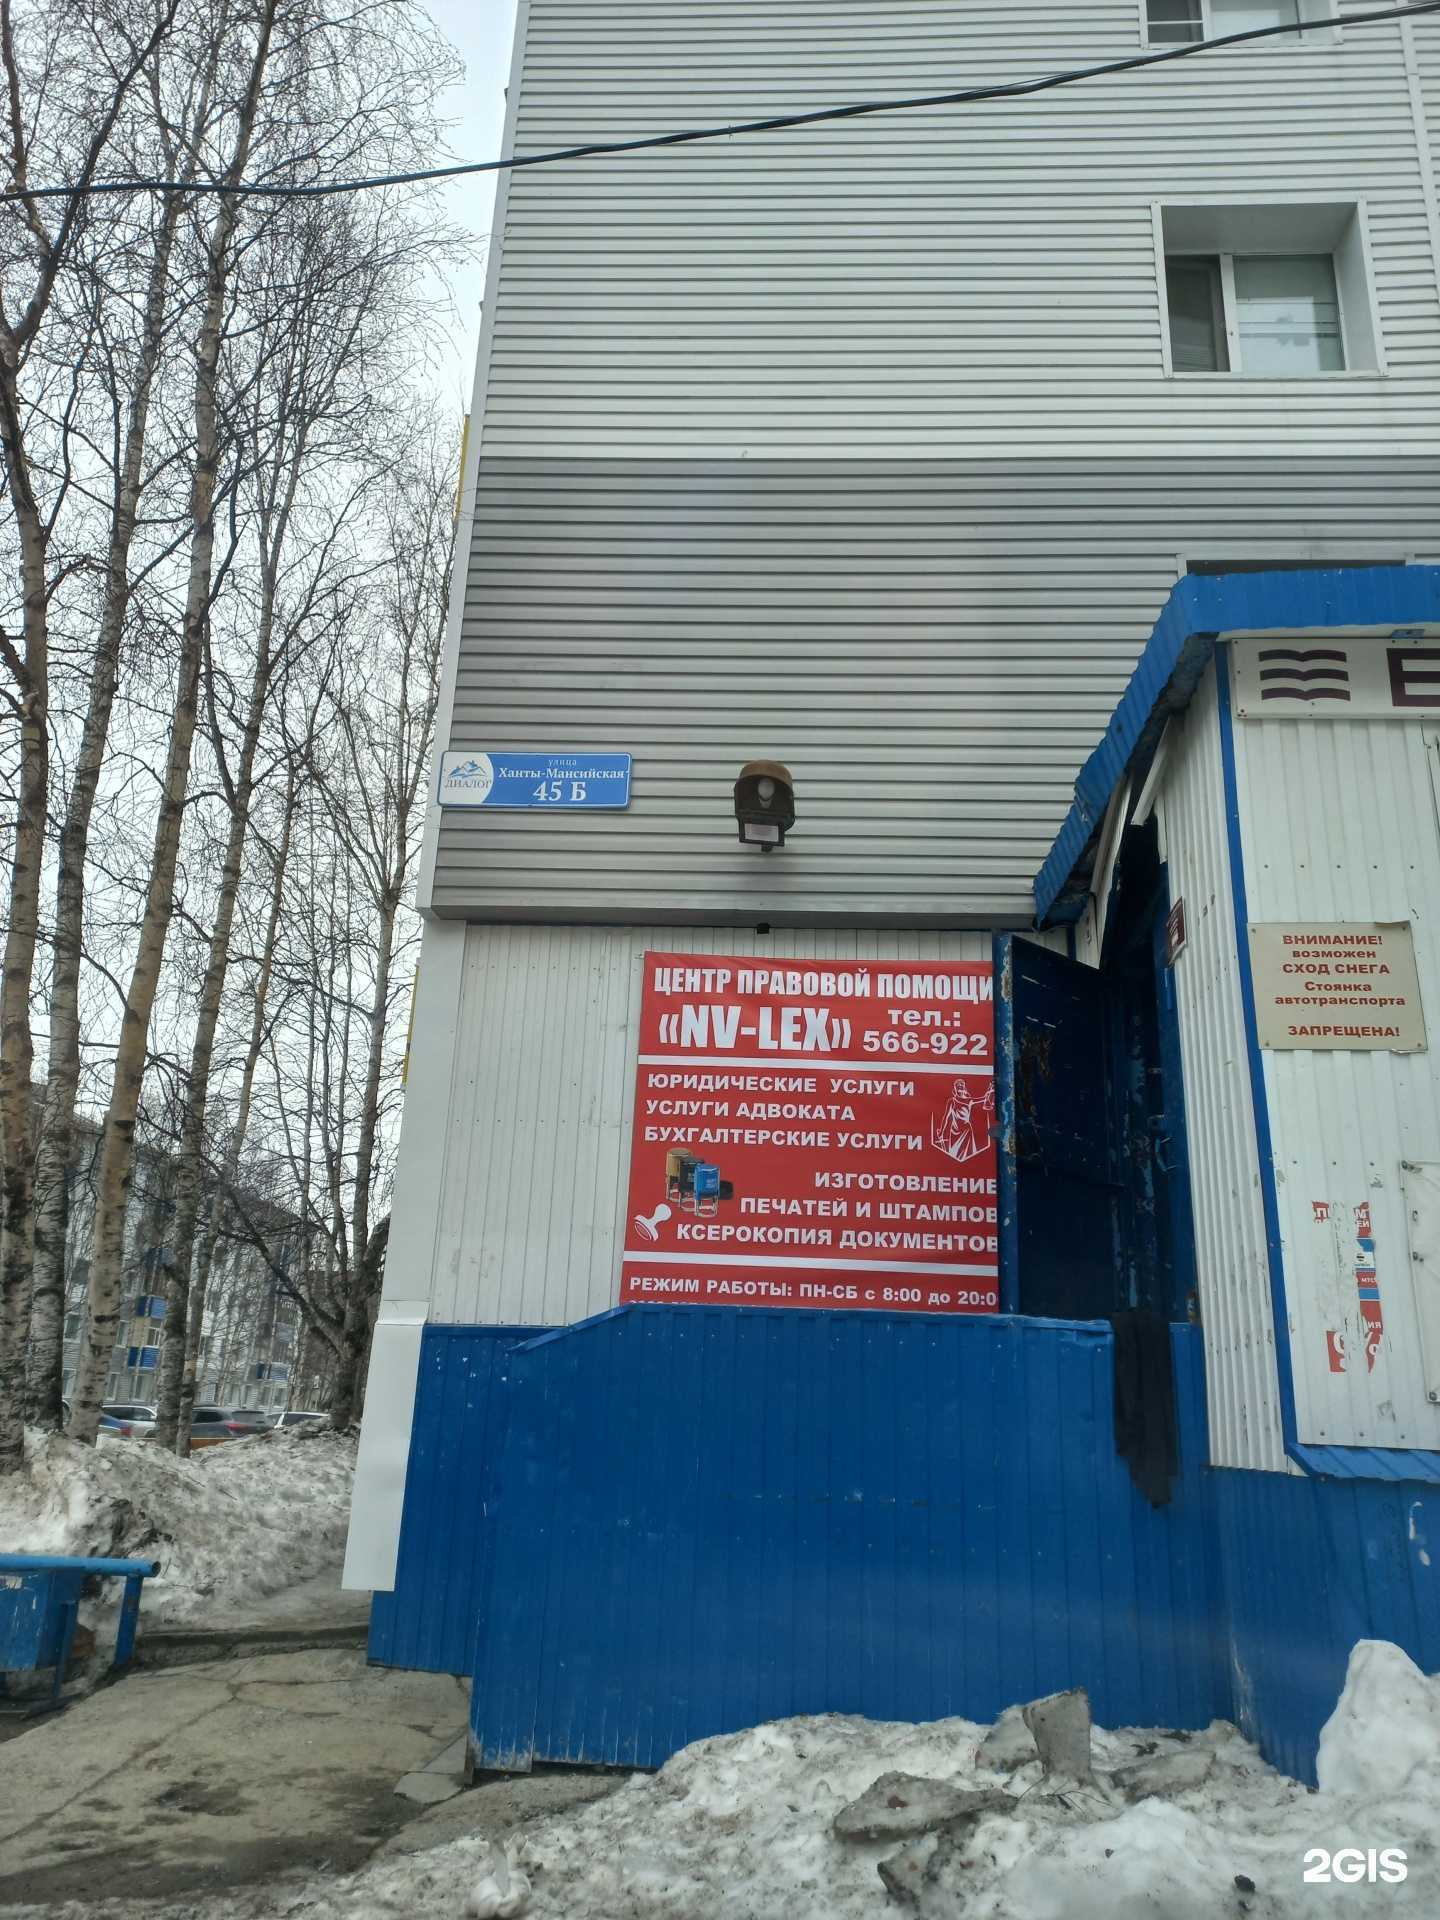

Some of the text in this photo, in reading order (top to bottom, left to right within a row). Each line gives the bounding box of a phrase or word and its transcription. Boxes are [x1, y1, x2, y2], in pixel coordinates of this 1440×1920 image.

[498, 767, 625, 779] Ханты-Мансийская
[548, 759, 577, 769] улица
[445, 780, 491, 789] ДИАЛОГ
[533, 781, 587, 801] 45 Б
[1282, 935, 1383, 946] ВНИМАНИЕ!
[1292, 950, 1377, 959] возможен
[1282, 963, 1391, 976] СХОД СНЕГА
[654, 967, 994, 1005] ЦЕНТР ПРАВОВОЙ ПОМОЩИ
[1304, 981, 1372, 992] Стоянка
[1274, 996, 1406, 1008] автотранспорта
[658, 1004, 961, 1052] «NV-LEX» тел.:
[1287, 1025, 1401, 1039] ЗАПРЕЩЕНА!
[863, 1030, 988, 1056] 566-922
[647, 1073, 914, 1096] ЮРИДИЧЕСКИЕ УСЛУГИ
[646, 1099, 856, 1121] УСЛУГИ АДВОКАТА
[644, 1126, 922, 1151] БУХГАЛТЕРСКИЕ УСЛУГИ
[815, 1172, 997, 1194] ИЗГОТОВЛЕНИЕ
[740, 1197, 997, 1223] ПЕЧАТЕЙ И ШТАМПОВ
[677, 1223, 998, 1252] КСЕРОКОПИЯ ДОКУМЕНТОВ
[629, 1277, 997, 1306] РЕЖИМ РАБОТЫ: ПН-СБ с 8:00 до 20:0
